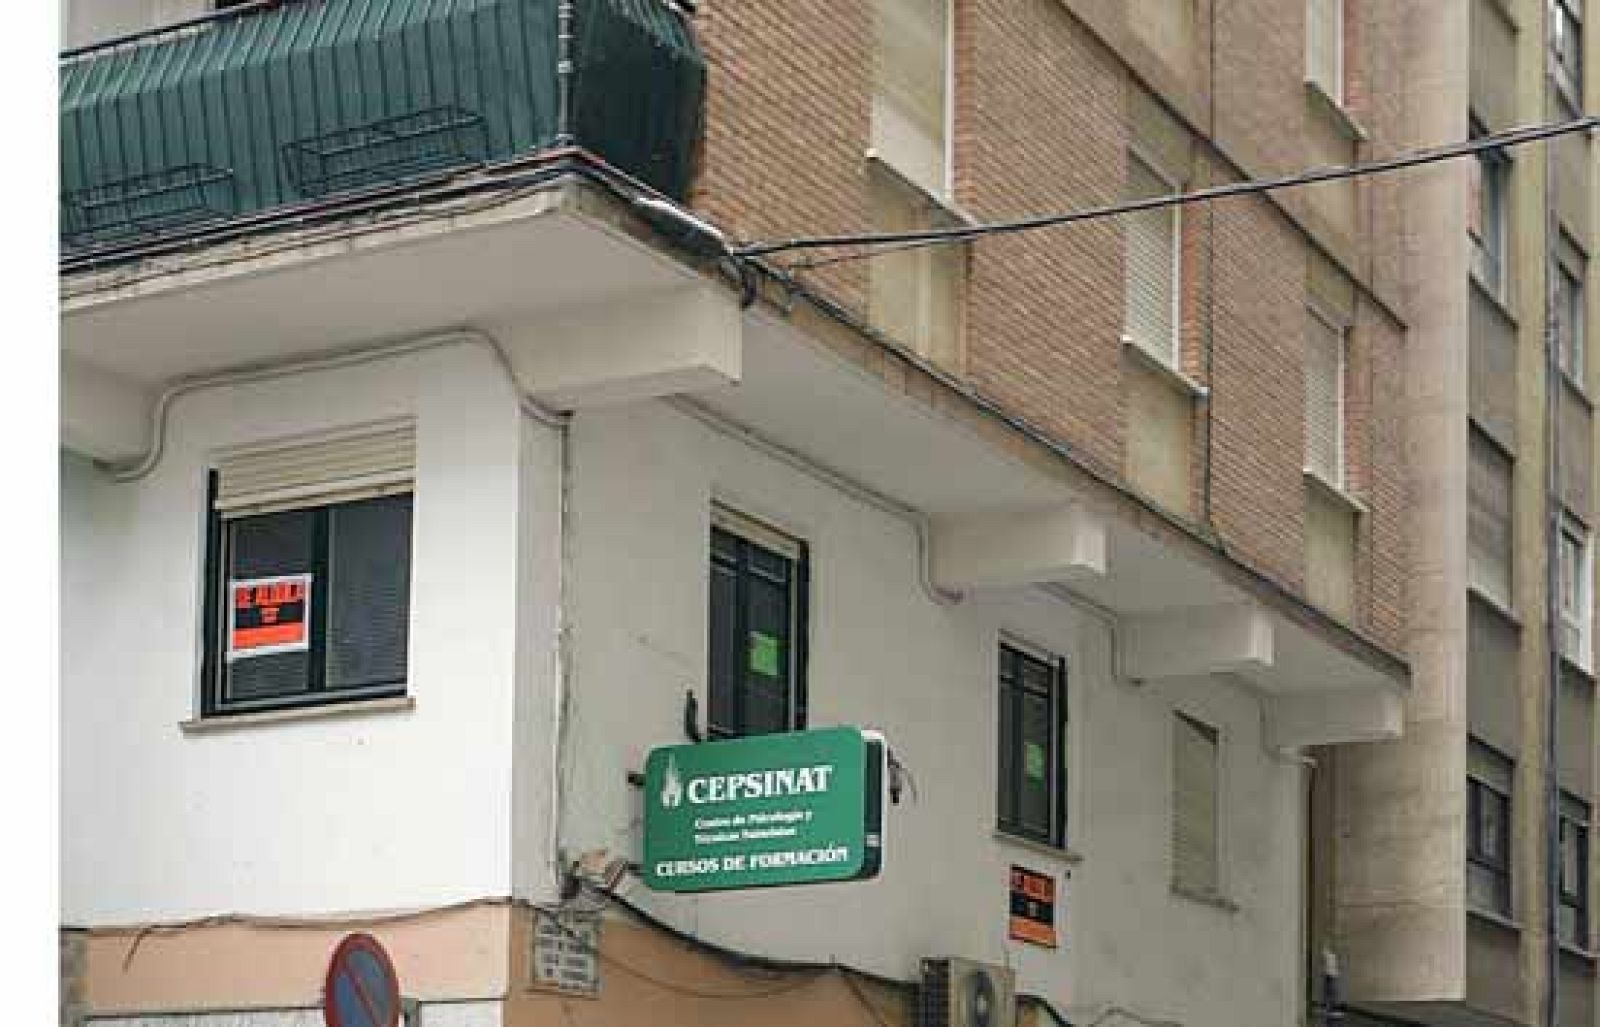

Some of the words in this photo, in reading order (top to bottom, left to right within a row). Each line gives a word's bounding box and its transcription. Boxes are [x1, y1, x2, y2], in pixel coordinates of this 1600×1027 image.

[687, 765, 833, 804] CEPSINAT
[656, 857, 720, 877] CURSOS
[723, 854, 746, 871] DE
[750, 842, 849, 869] FORMACIÓN
